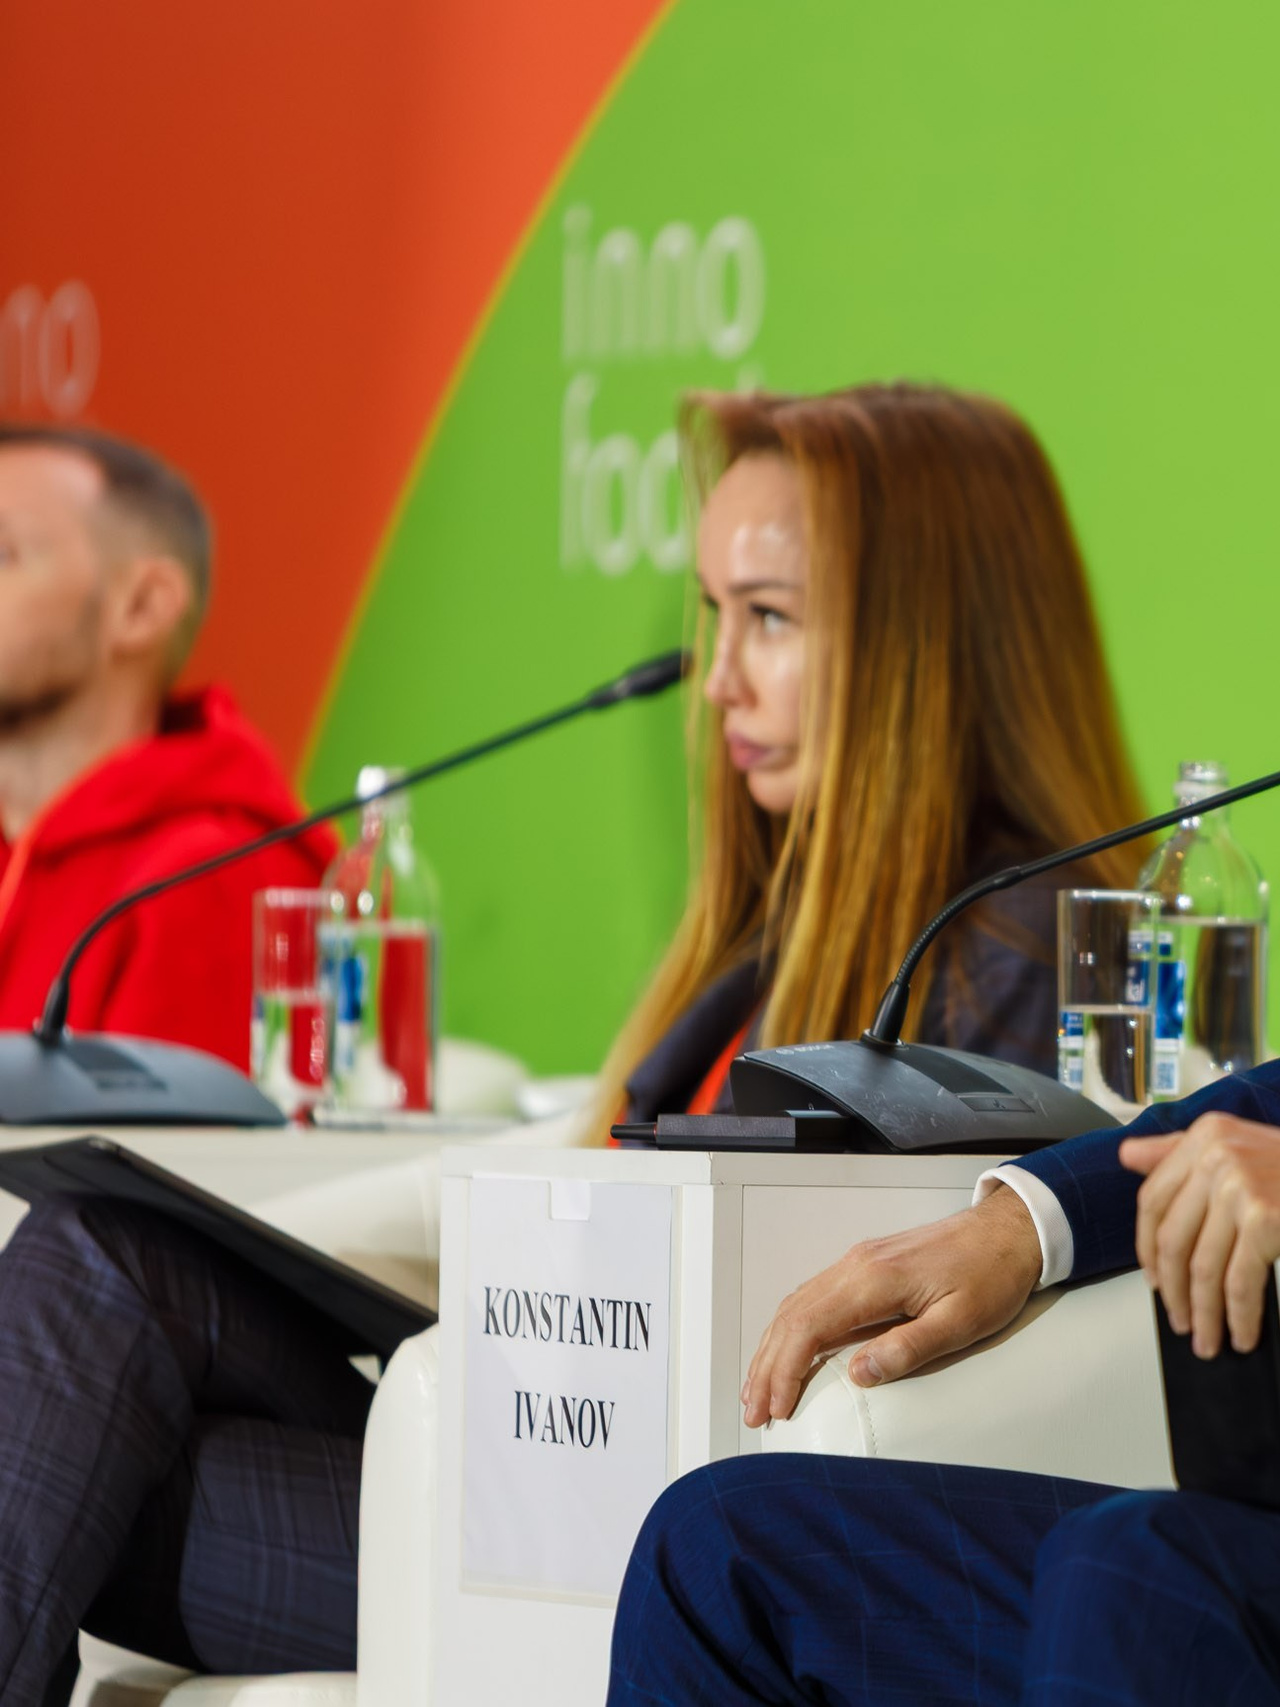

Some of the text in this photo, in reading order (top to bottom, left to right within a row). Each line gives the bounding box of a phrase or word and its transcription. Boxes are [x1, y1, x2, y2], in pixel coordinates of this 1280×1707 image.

[562, 203, 765, 362] inno
[484, 1287, 652, 1351] KONSTANTIN
[514, 1390, 615, 1450] IVANOV
